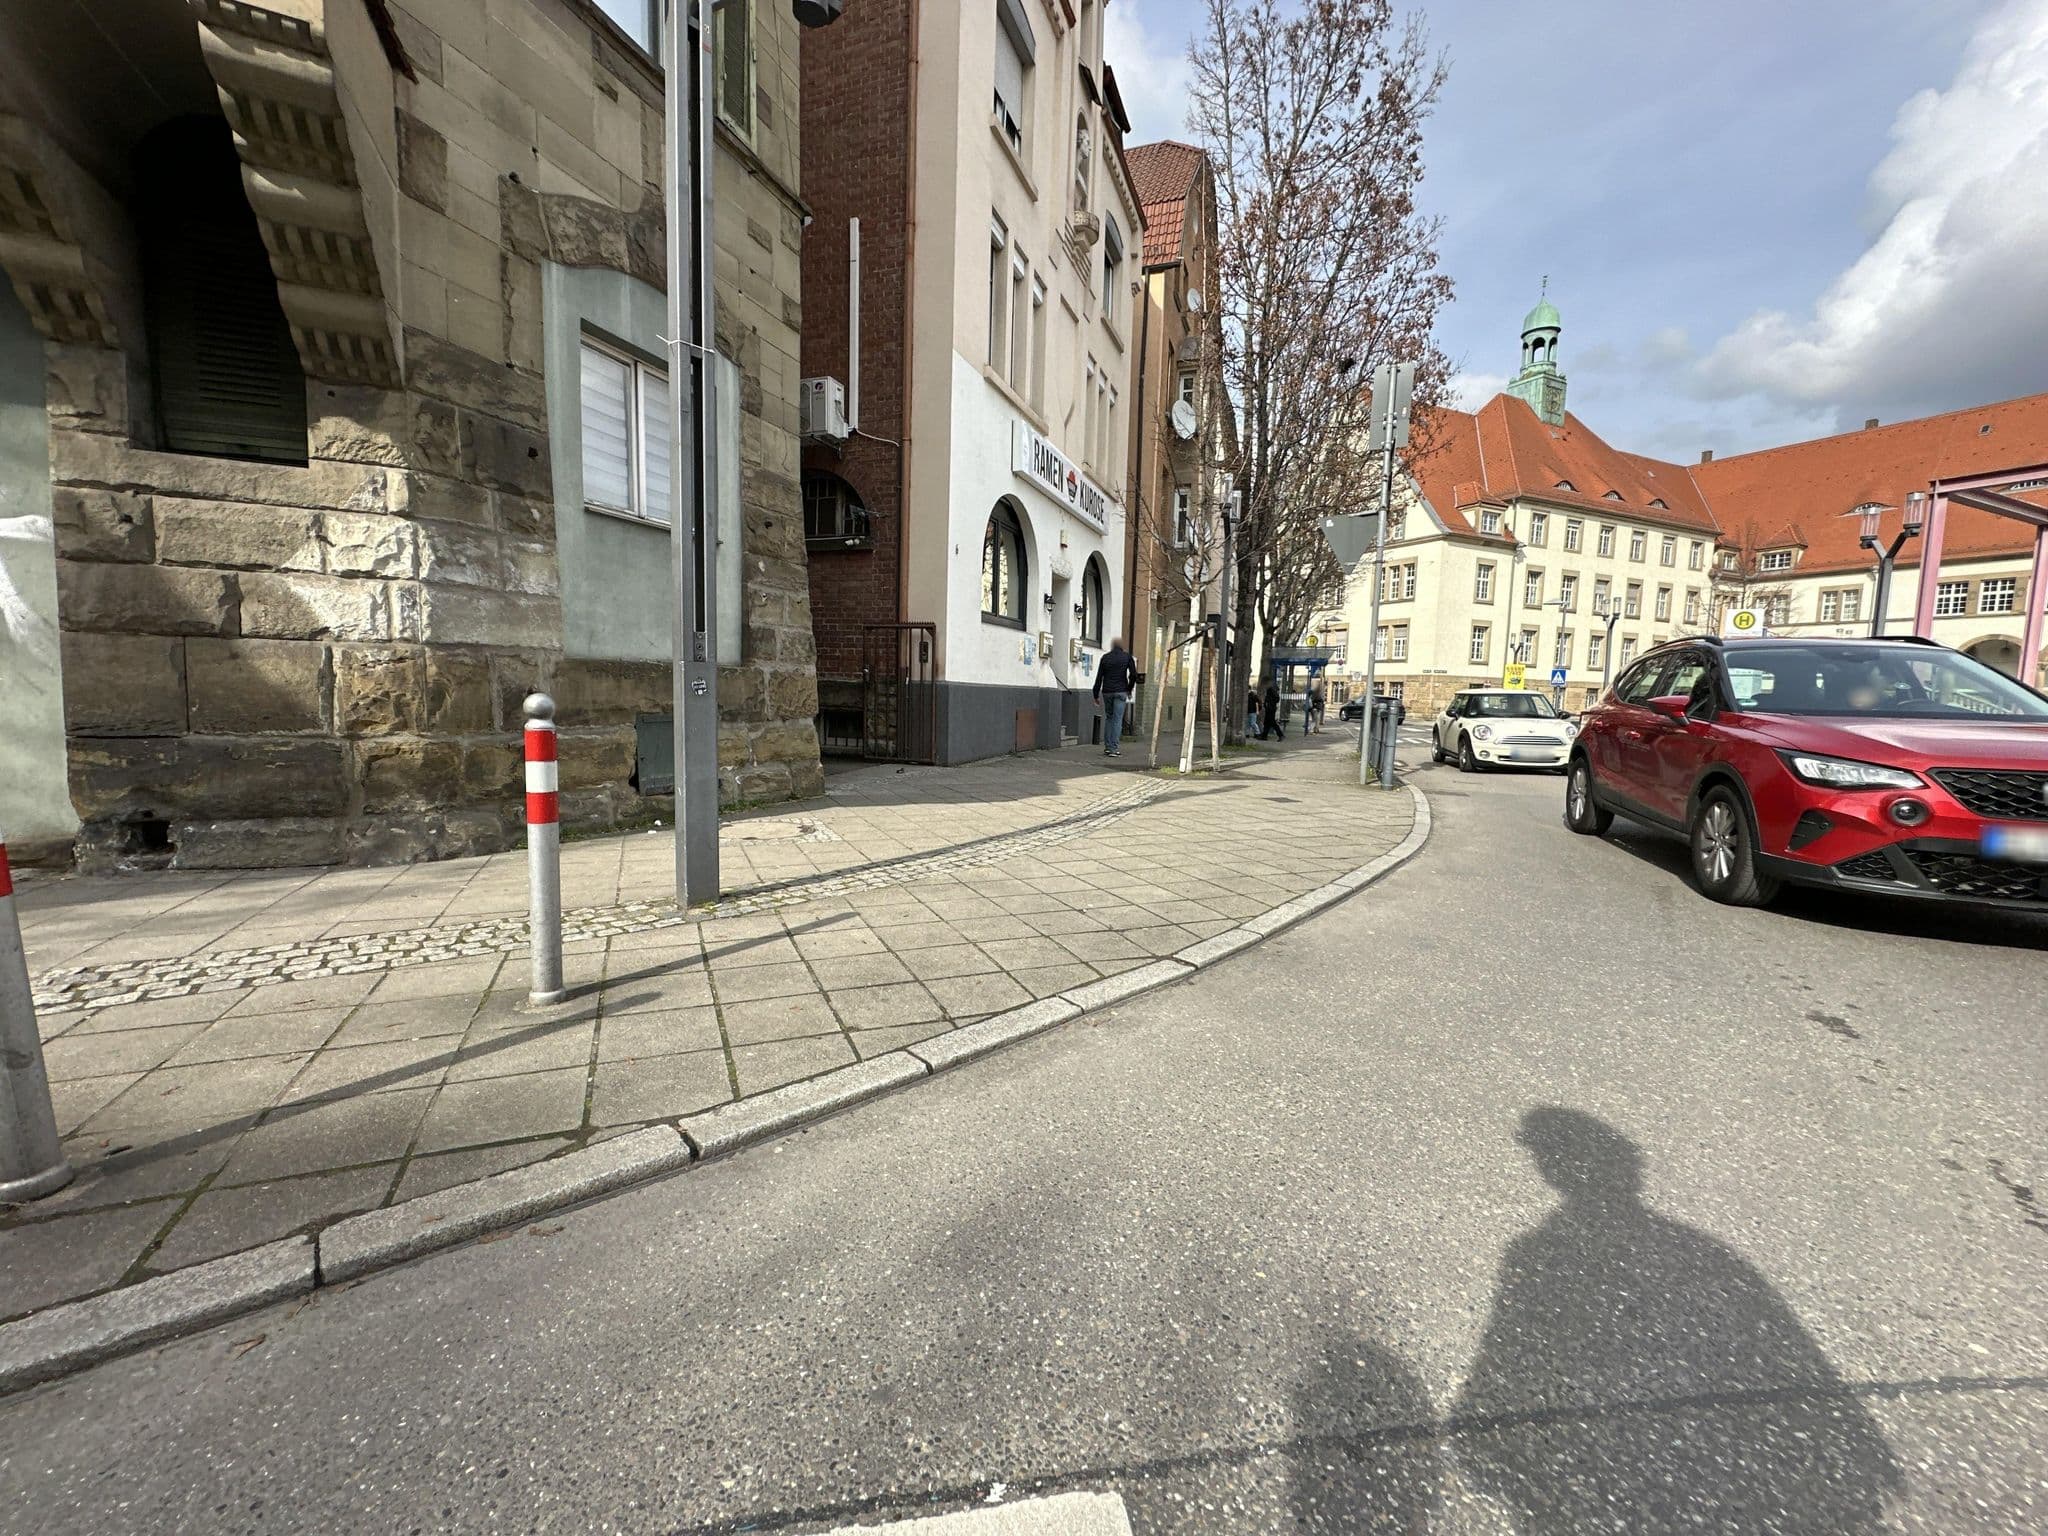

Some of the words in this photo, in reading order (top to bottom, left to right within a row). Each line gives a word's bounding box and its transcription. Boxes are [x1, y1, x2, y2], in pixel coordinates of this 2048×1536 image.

[1034, 438, 1064, 493] RAMEN
[1079, 479, 1104, 524] KUROSE
[1739, 616, 1750, 626] H
